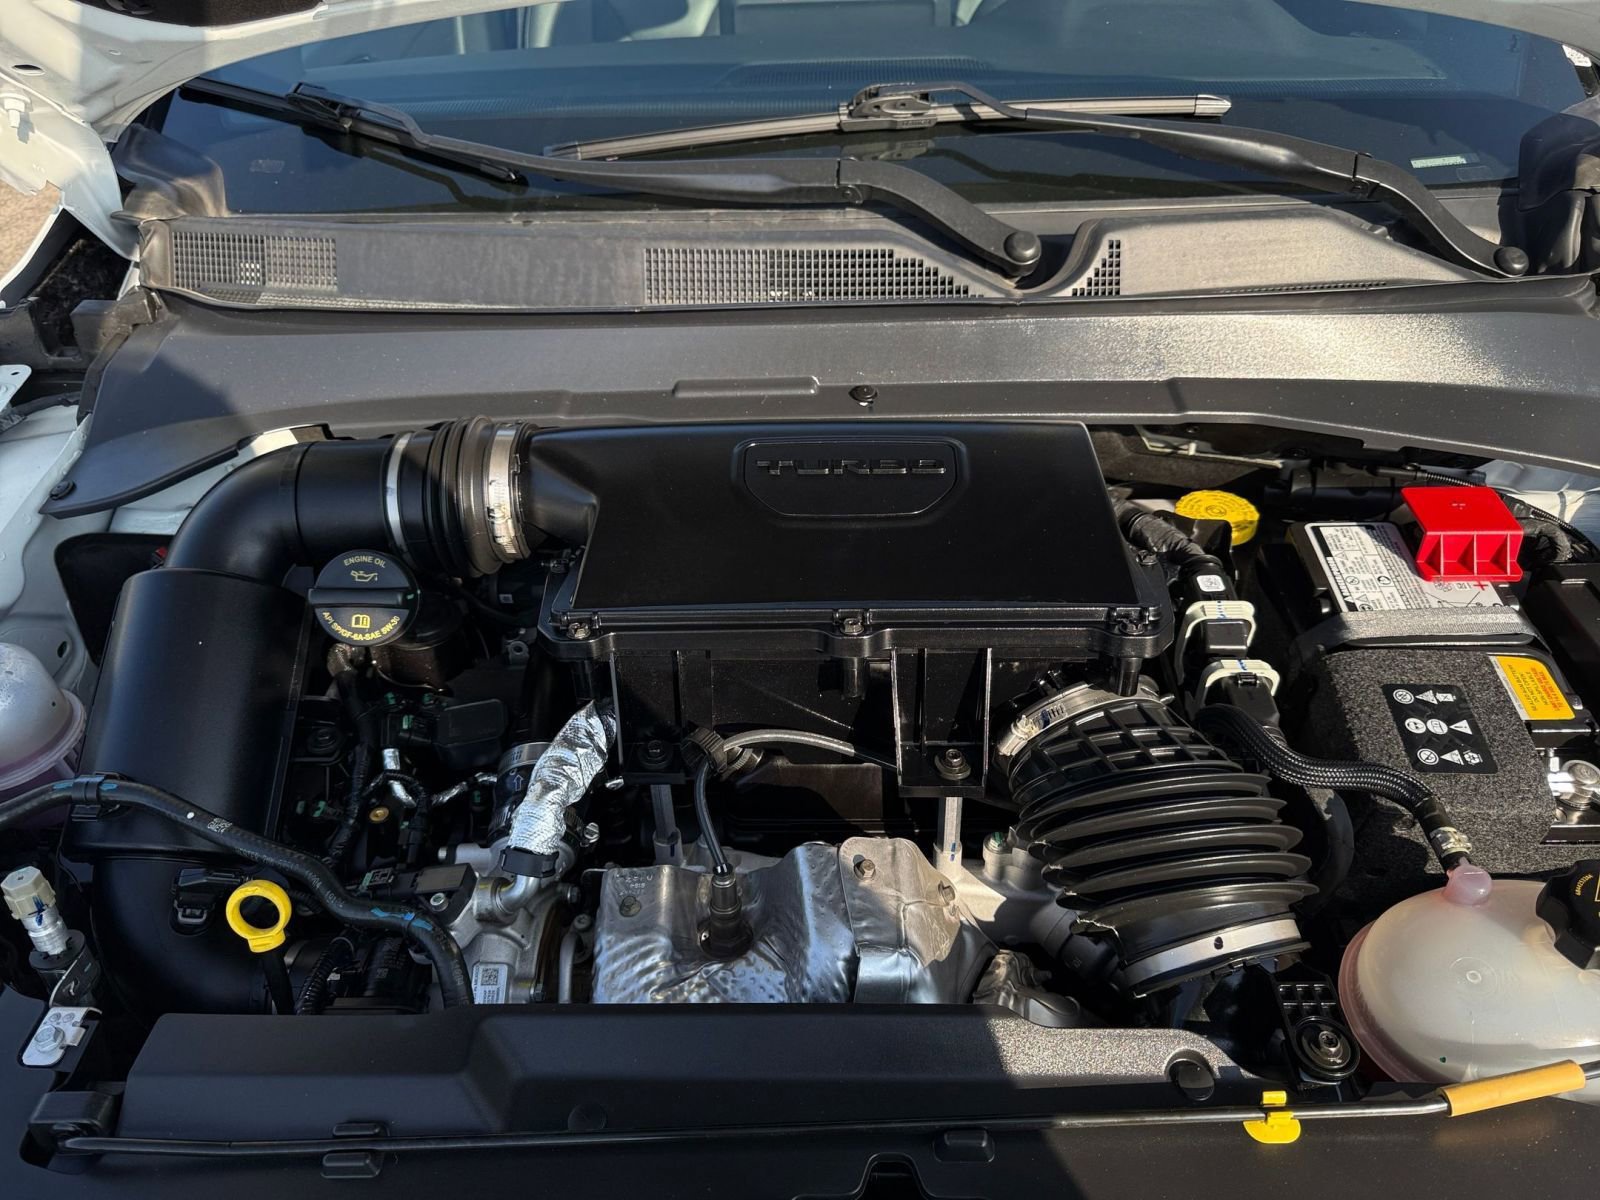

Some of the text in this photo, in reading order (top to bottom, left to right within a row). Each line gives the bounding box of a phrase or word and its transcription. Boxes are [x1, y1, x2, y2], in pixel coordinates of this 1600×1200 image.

[755, 458, 947, 475] TURBO
[343, 555, 386, 568] ENGINE OIL
[322, 611, 334, 626] API
[380, 615, 401, 635] 5W-30
